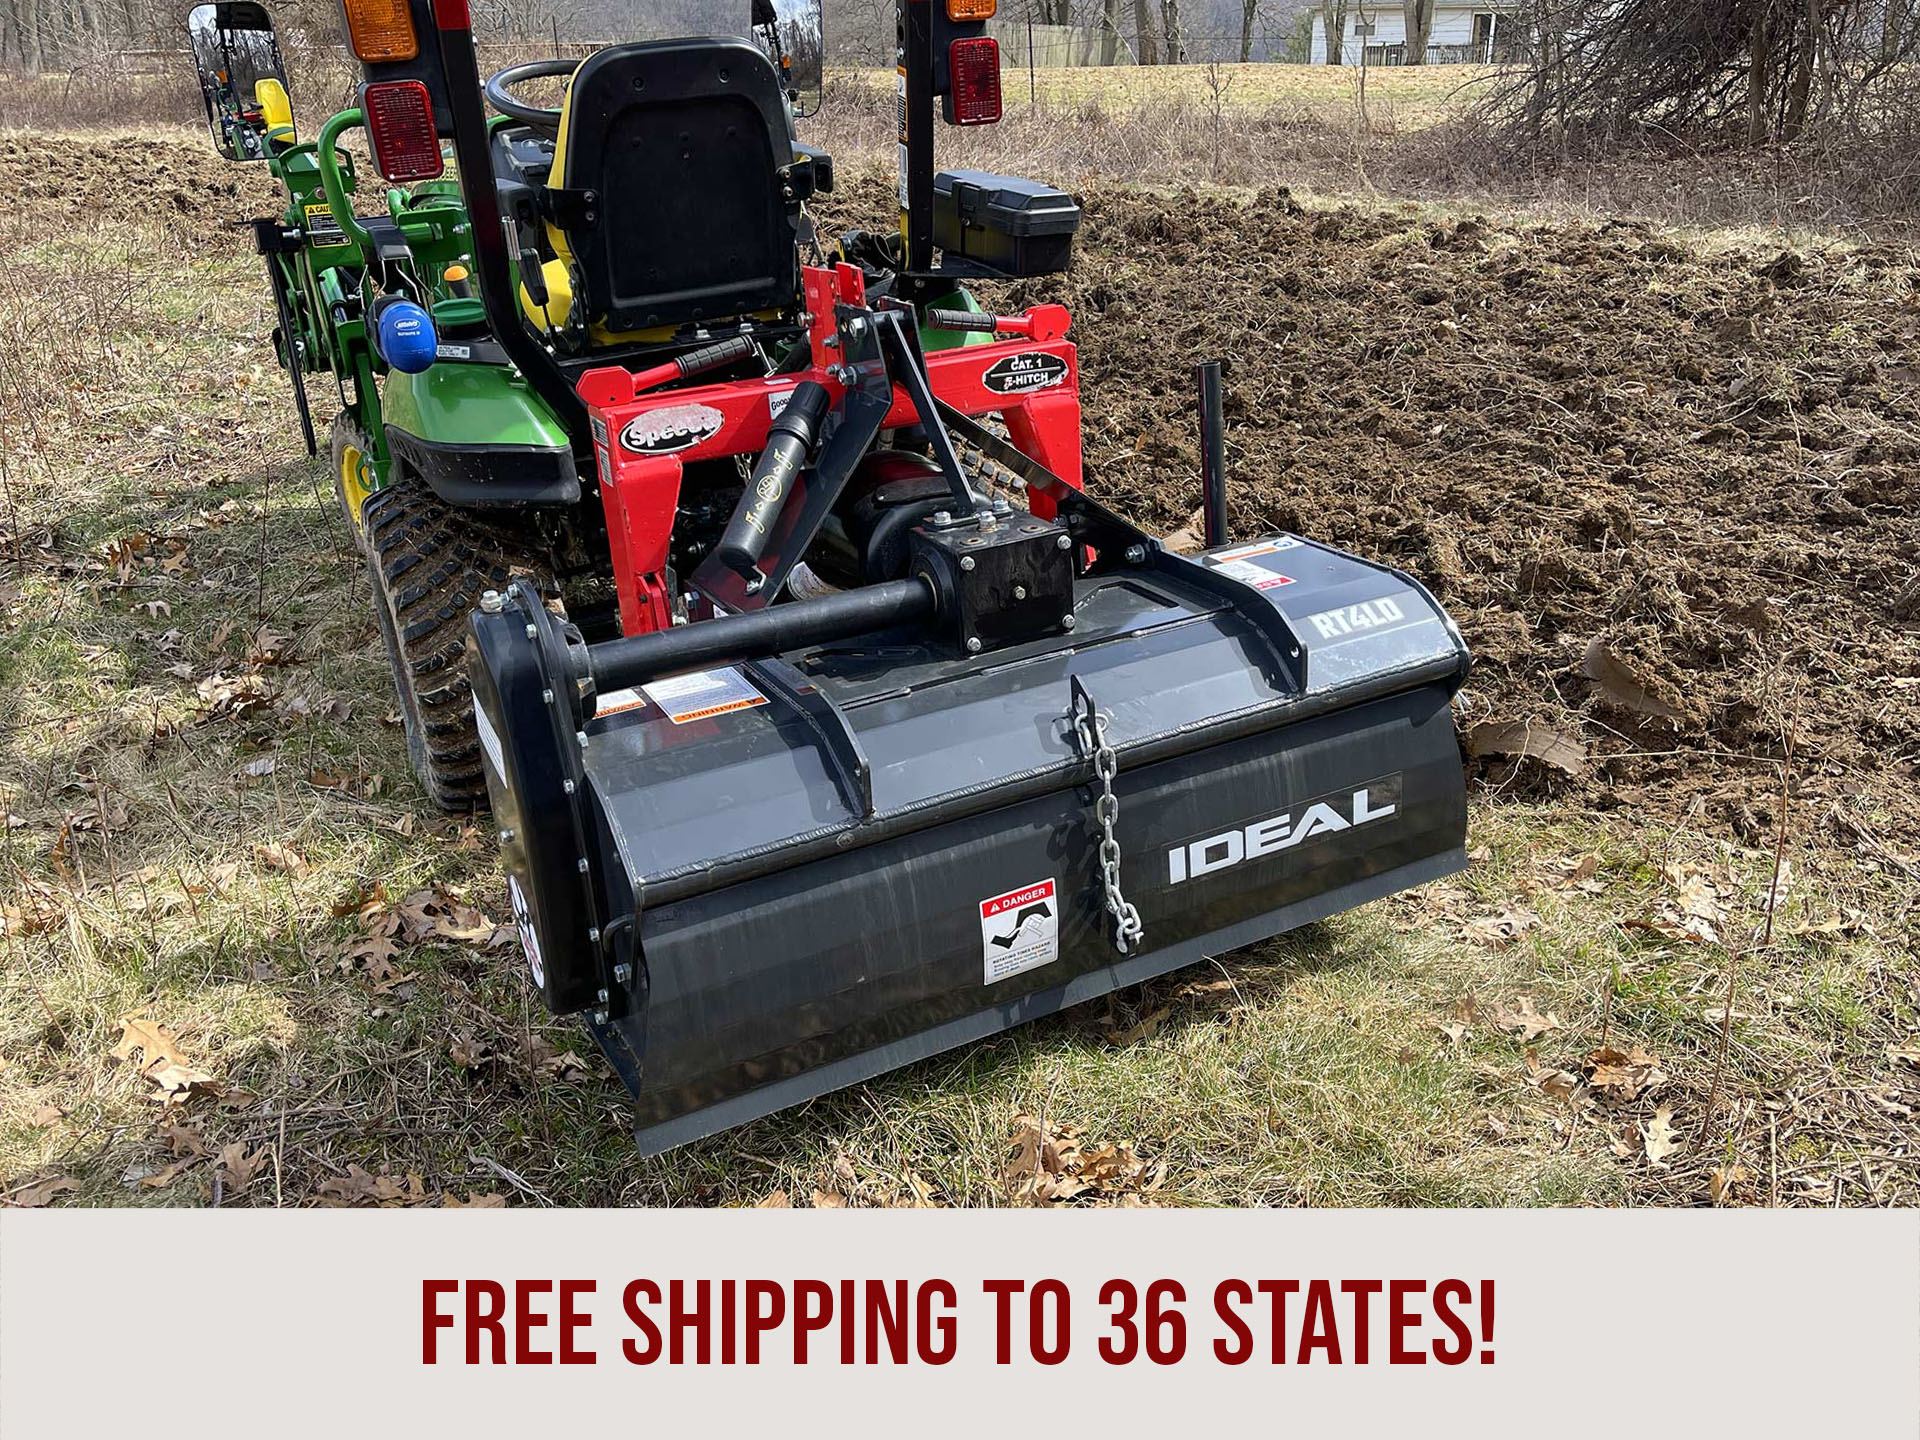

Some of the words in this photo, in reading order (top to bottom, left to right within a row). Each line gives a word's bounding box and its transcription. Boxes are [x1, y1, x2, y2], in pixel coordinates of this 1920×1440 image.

[1011, 360, 1033, 371] CAT.
[1036, 358, 1042, 368] 1
[1308, 598, 1405, 639] RT4LD
[1168, 788, 1396, 885] IDEAL
[1002, 888, 1046, 908] DANGER
